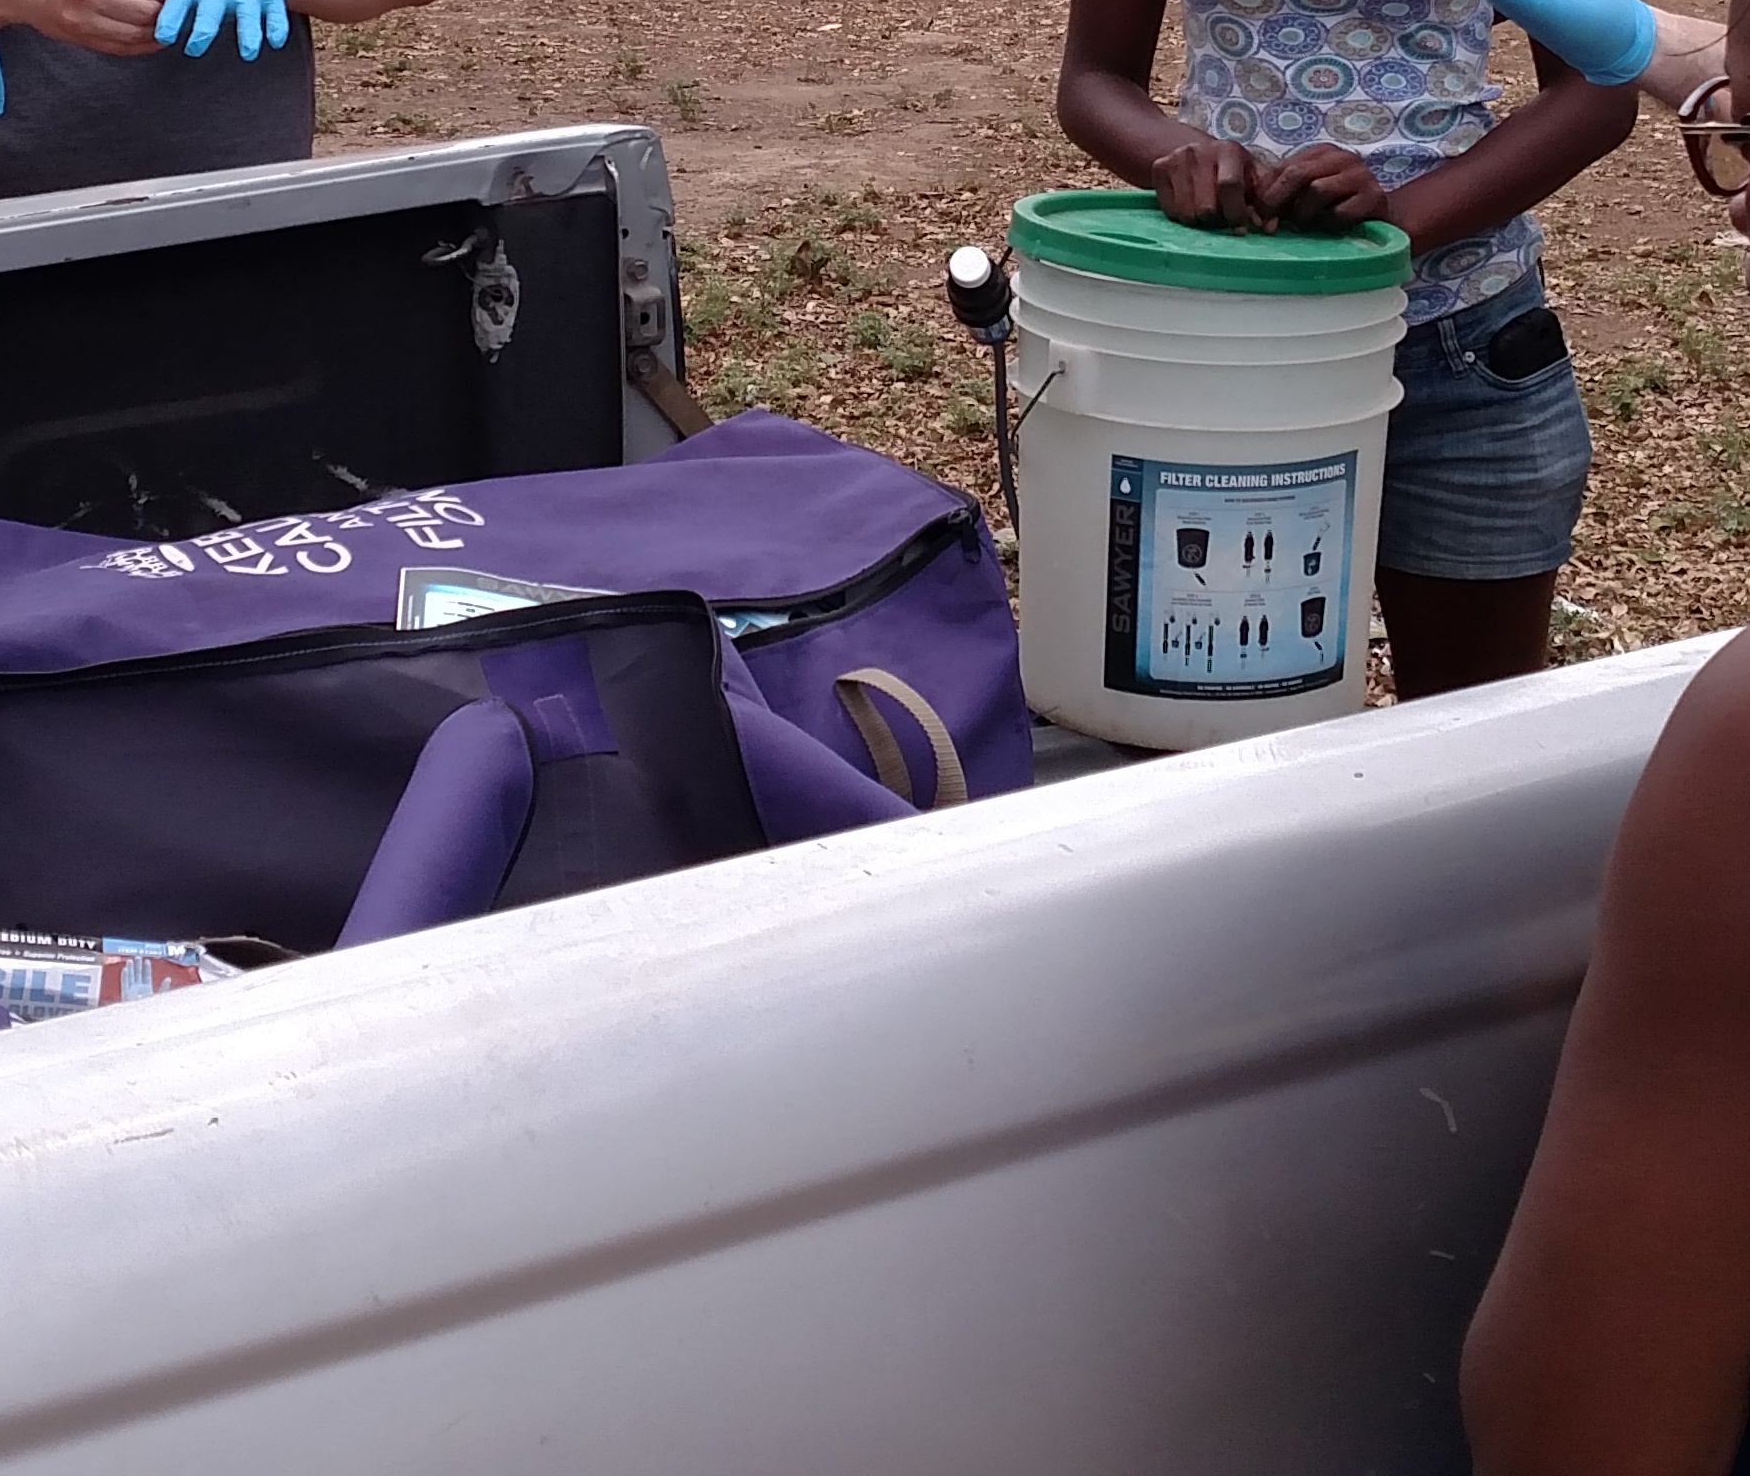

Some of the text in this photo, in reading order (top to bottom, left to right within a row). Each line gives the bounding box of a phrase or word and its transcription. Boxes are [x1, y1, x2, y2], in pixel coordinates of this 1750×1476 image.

[1160, 463, 1346, 488] FILTER CLEANING INSTRUCTIONS
[1112, 504, 1135, 634] SAWYER
[57, 936, 96, 950] DUTY
